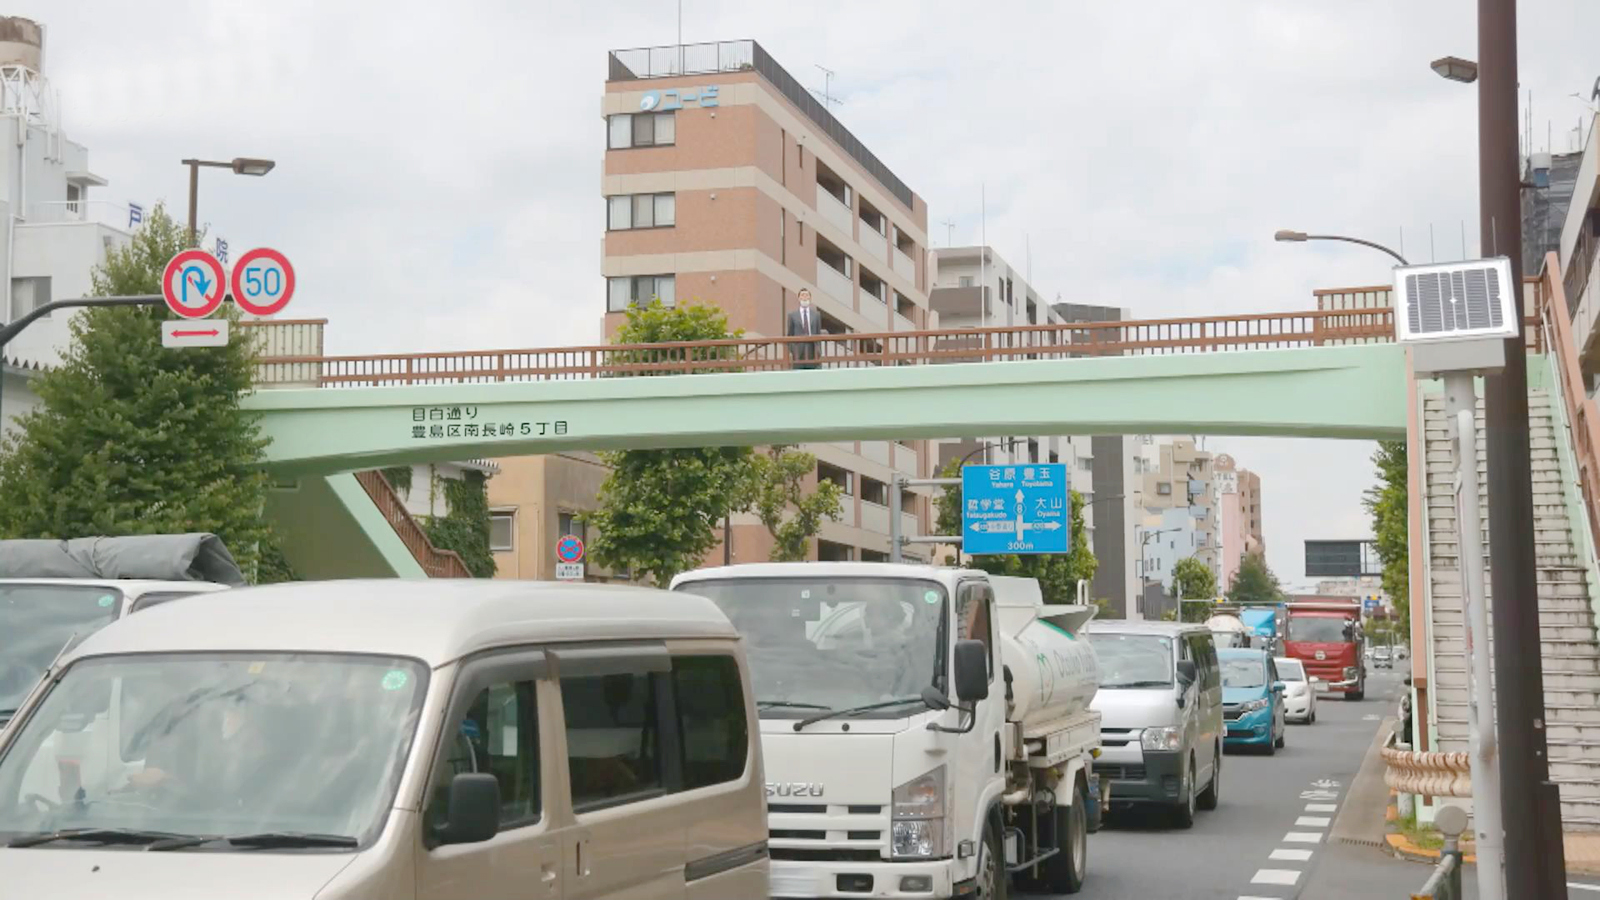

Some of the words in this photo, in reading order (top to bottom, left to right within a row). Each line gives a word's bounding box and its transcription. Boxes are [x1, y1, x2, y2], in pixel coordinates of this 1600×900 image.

[246, 267, 281, 297] 50
[412, 406, 478, 422] 目白通り
[989, 468, 1016, 480] 谷原
[1024, 467, 1050, 480] 豊玉
[1035, 497, 1062, 509] 大山
[1007, 541, 1034, 550] 300m
[765, 782, 824, 797] SUZU
